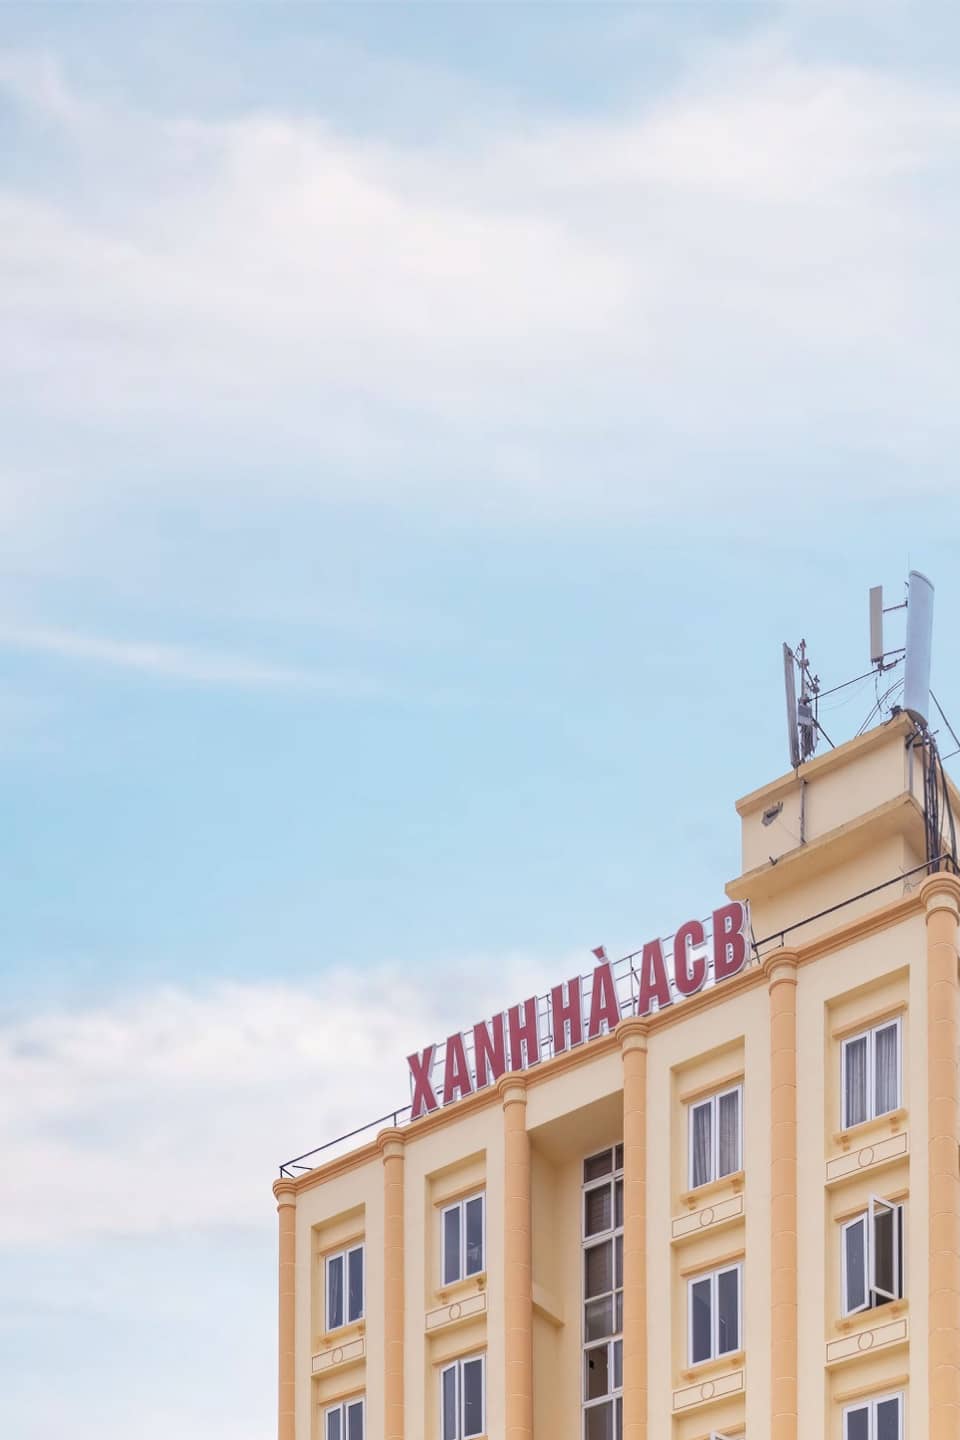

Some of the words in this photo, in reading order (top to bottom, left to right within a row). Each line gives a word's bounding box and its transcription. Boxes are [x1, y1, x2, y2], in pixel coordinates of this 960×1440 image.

[406, 996, 541, 1120] XANH
[550, 945, 623, 1056] HÀ
[636, 901, 749, 1016] ACB
